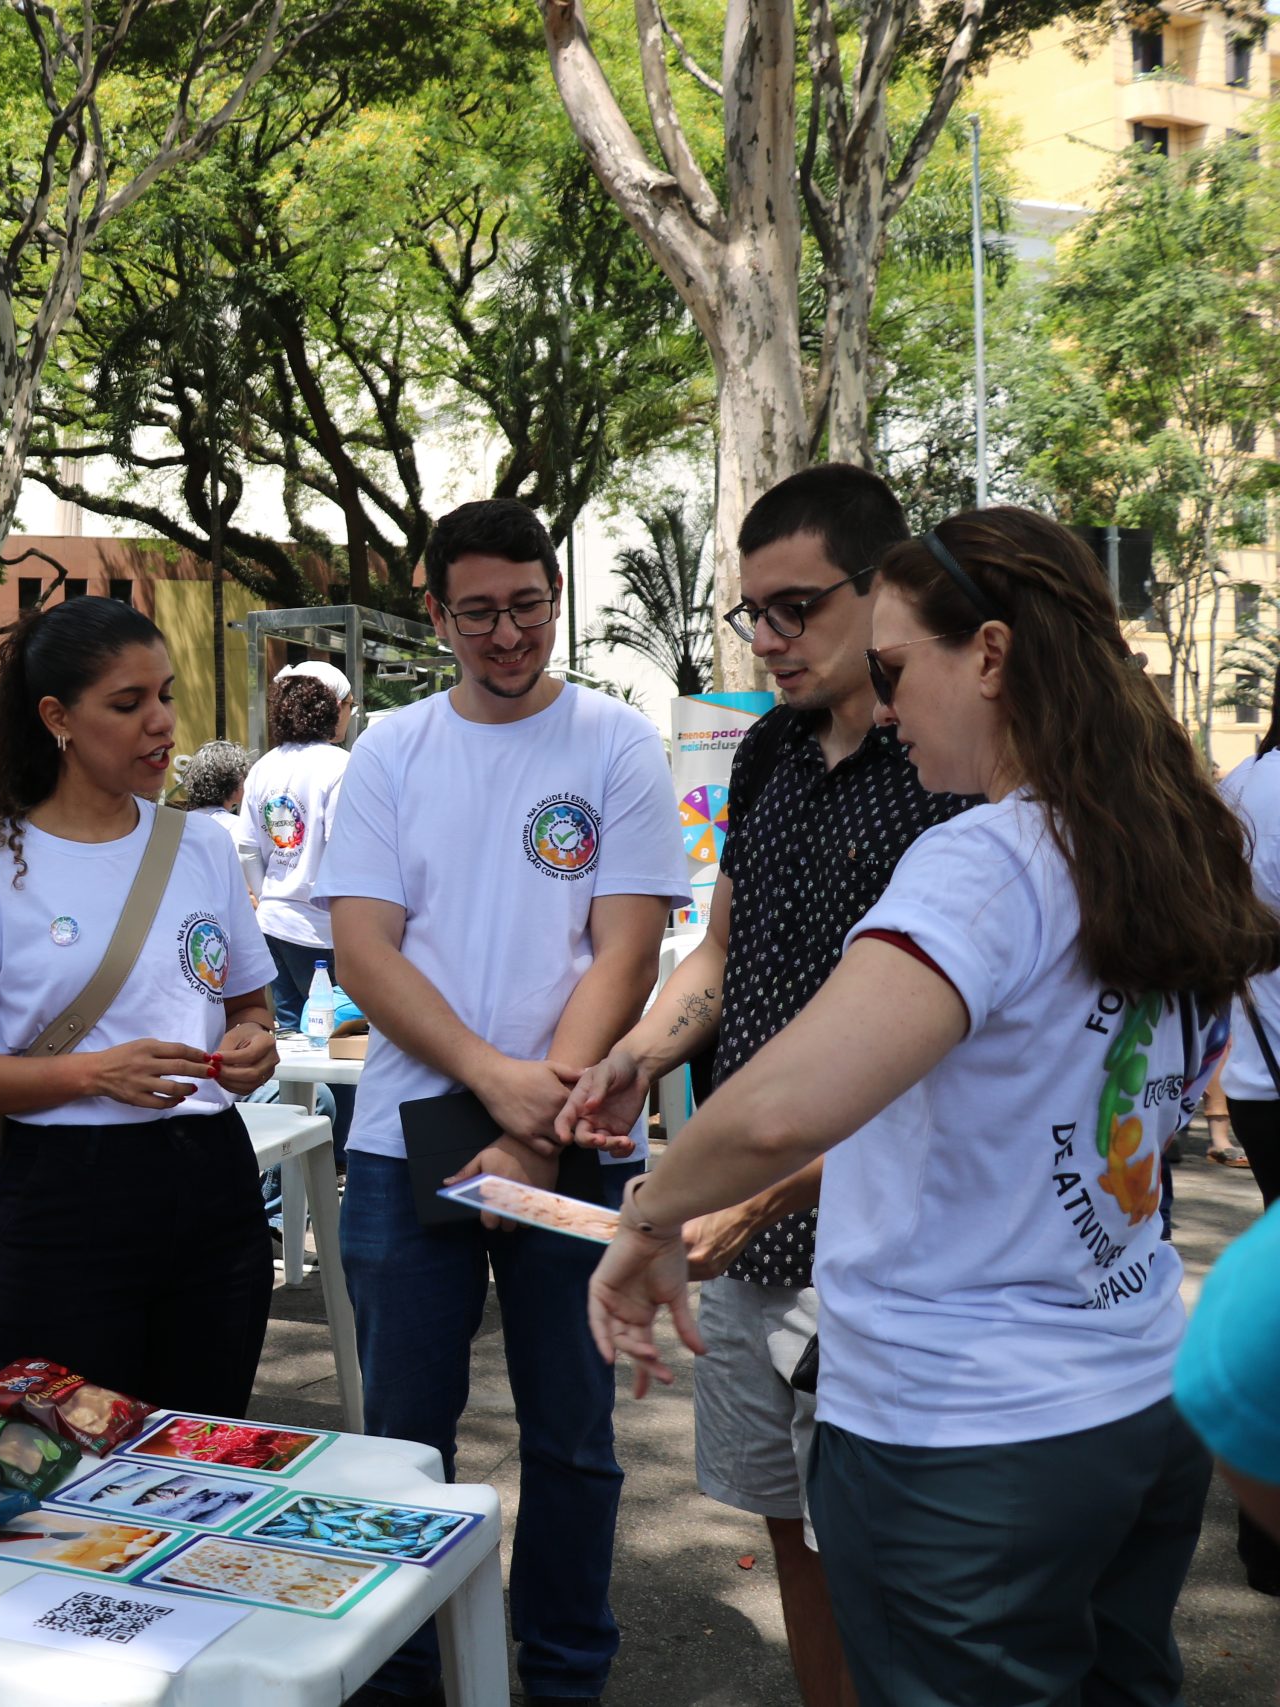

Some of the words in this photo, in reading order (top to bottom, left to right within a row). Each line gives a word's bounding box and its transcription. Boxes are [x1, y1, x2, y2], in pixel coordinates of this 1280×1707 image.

[691, 791, 702, 803] 3
[713, 788, 722, 799] 4
[527, 808, 538, 818] NA
[537, 793, 563, 808] SAÚDE
[565, 792, 569, 800] É
[571, 795, 602, 827] ESSENCIAL
[680, 812, 689, 820] 2
[522, 824, 541, 869] GRADUAÇÃO
[541, 867, 559, 879] COM
[561, 871, 584, 881] ENSINO
[700, 848, 709, 858] 8
[177, 930, 185, 941] NA
[181, 912, 201, 930] SAÚDE
[178, 949, 205, 995] GRADUAÇÃO
[1052, 1121, 1076, 1166] DE
